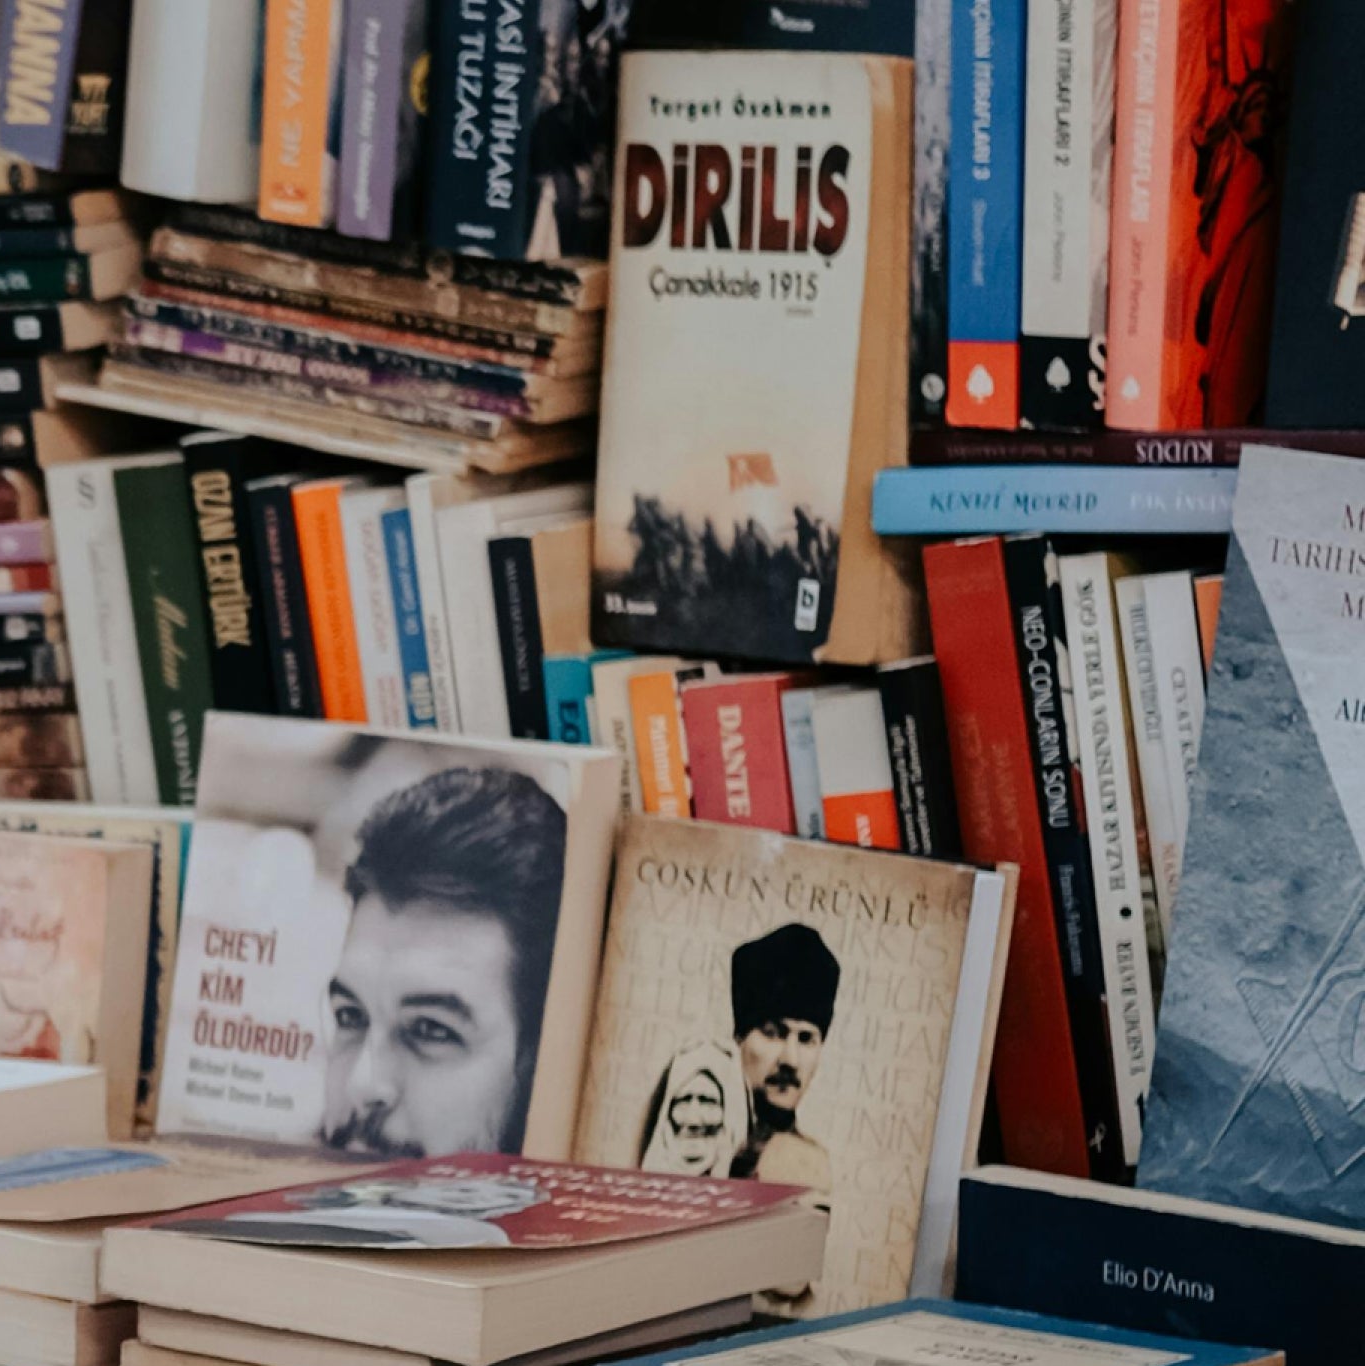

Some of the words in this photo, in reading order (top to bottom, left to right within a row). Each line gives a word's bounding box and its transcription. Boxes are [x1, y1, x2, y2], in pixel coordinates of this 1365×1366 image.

[4, 0, 65, 125] ANNA
[622, 142, 851, 269] DİRİLİŞ
[648, 264, 761, 302] Çanakkale
[769, 270, 820, 301] 1915
[190, 470, 236, 542] OZAN
[201, 543, 253, 649] ERTÜRK
[1080, 628, 1108, 702] YERLE
[1019, 604, 1062, 769] NEO-CONLARIN
[1042, 768, 1070, 828] SONU
[716, 703, 754, 820] DANTE
[1102, 819, 1128, 894] HAZAR
[199, 966, 245, 1008] KİM
[192, 1006, 315, 1063] ÖLDÜRDÜ?
[1102, 1259, 1140, 1290] Elio
[1142, 1267, 1216, 1303] D'Anna
